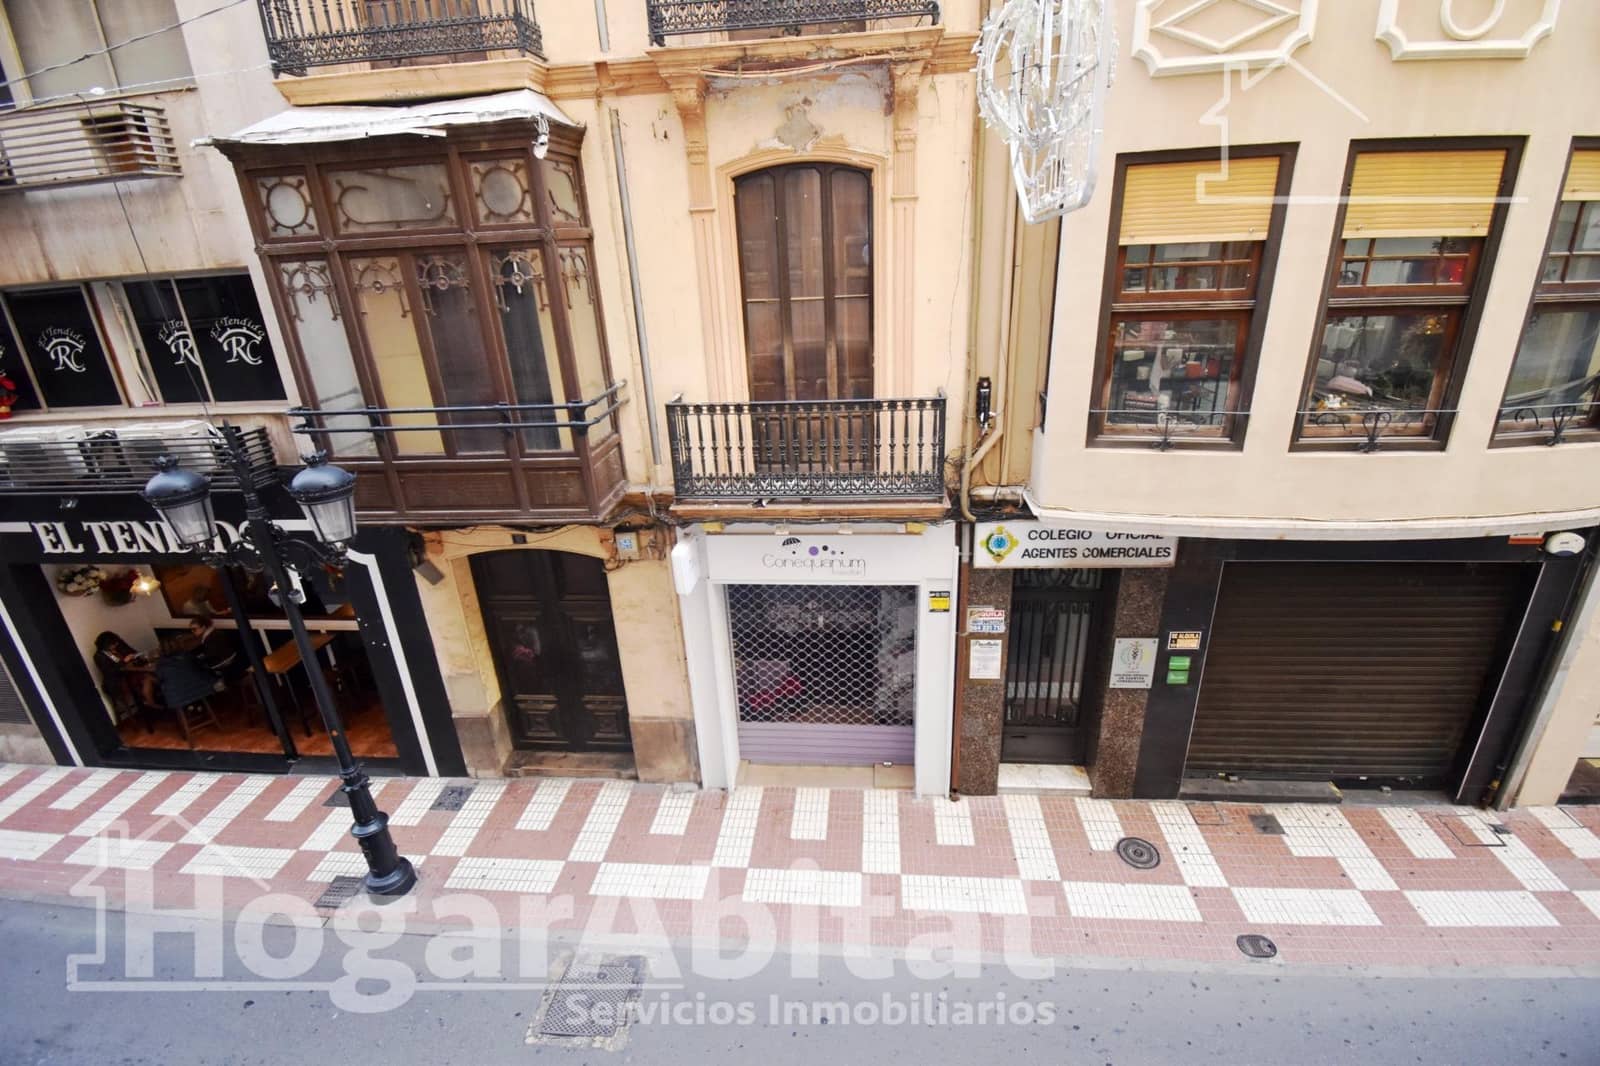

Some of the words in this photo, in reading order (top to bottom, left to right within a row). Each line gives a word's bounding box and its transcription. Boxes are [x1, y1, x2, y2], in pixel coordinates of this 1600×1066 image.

[220, 315, 266, 338] Tendido
[50, 345, 87, 373] RC
[222, 335, 263, 366] RC
[31, 521, 84, 554] EL
[1027, 529, 1092, 541] COLEGIO
[1021, 547, 1077, 559] AGENTES
[1082, 546, 1171, 559] COMERCIALES
